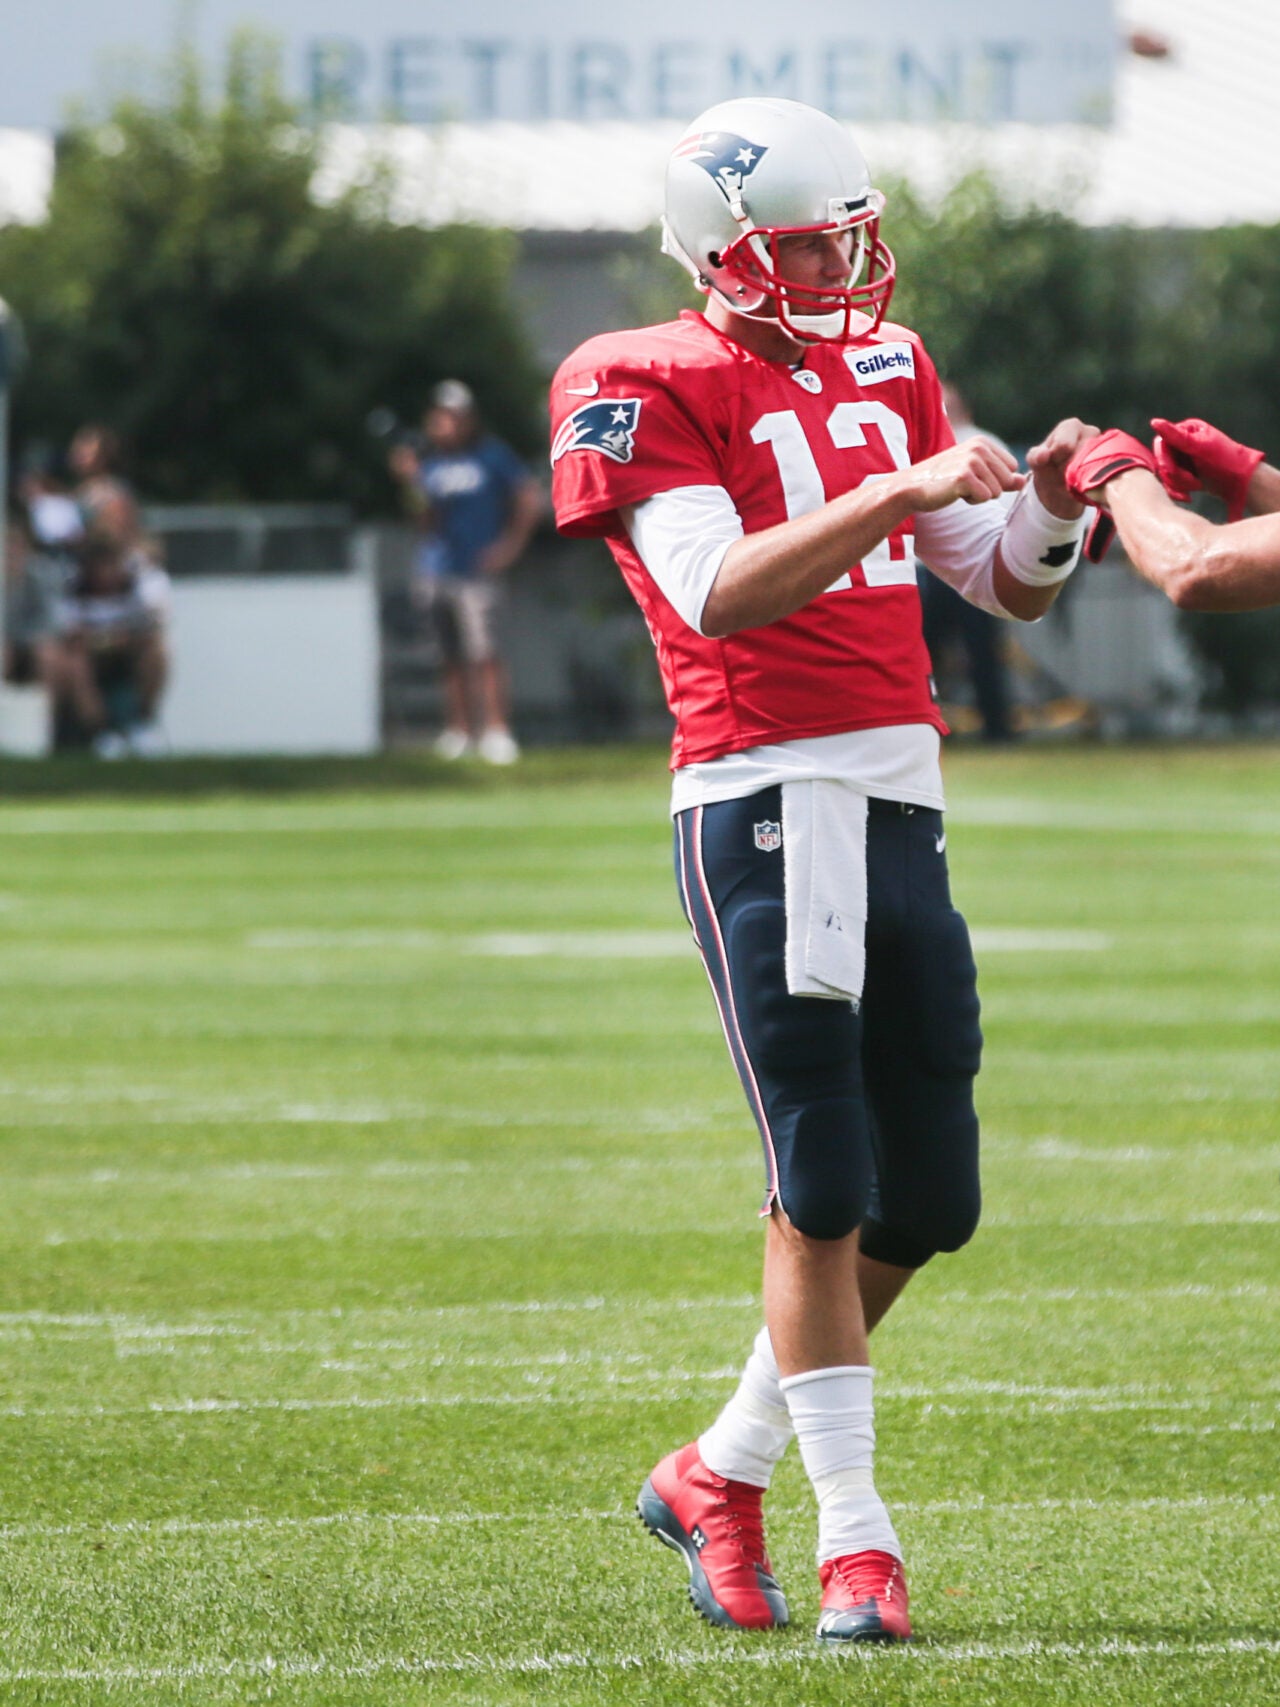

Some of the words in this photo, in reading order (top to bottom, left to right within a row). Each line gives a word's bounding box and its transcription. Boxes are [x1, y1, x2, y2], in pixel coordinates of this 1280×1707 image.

[309, 40, 1028, 121] RETIREMENT
[855, 352, 912, 375] Gillette
[750, 402, 917, 593] 12
[759, 833, 778, 847] NFL
